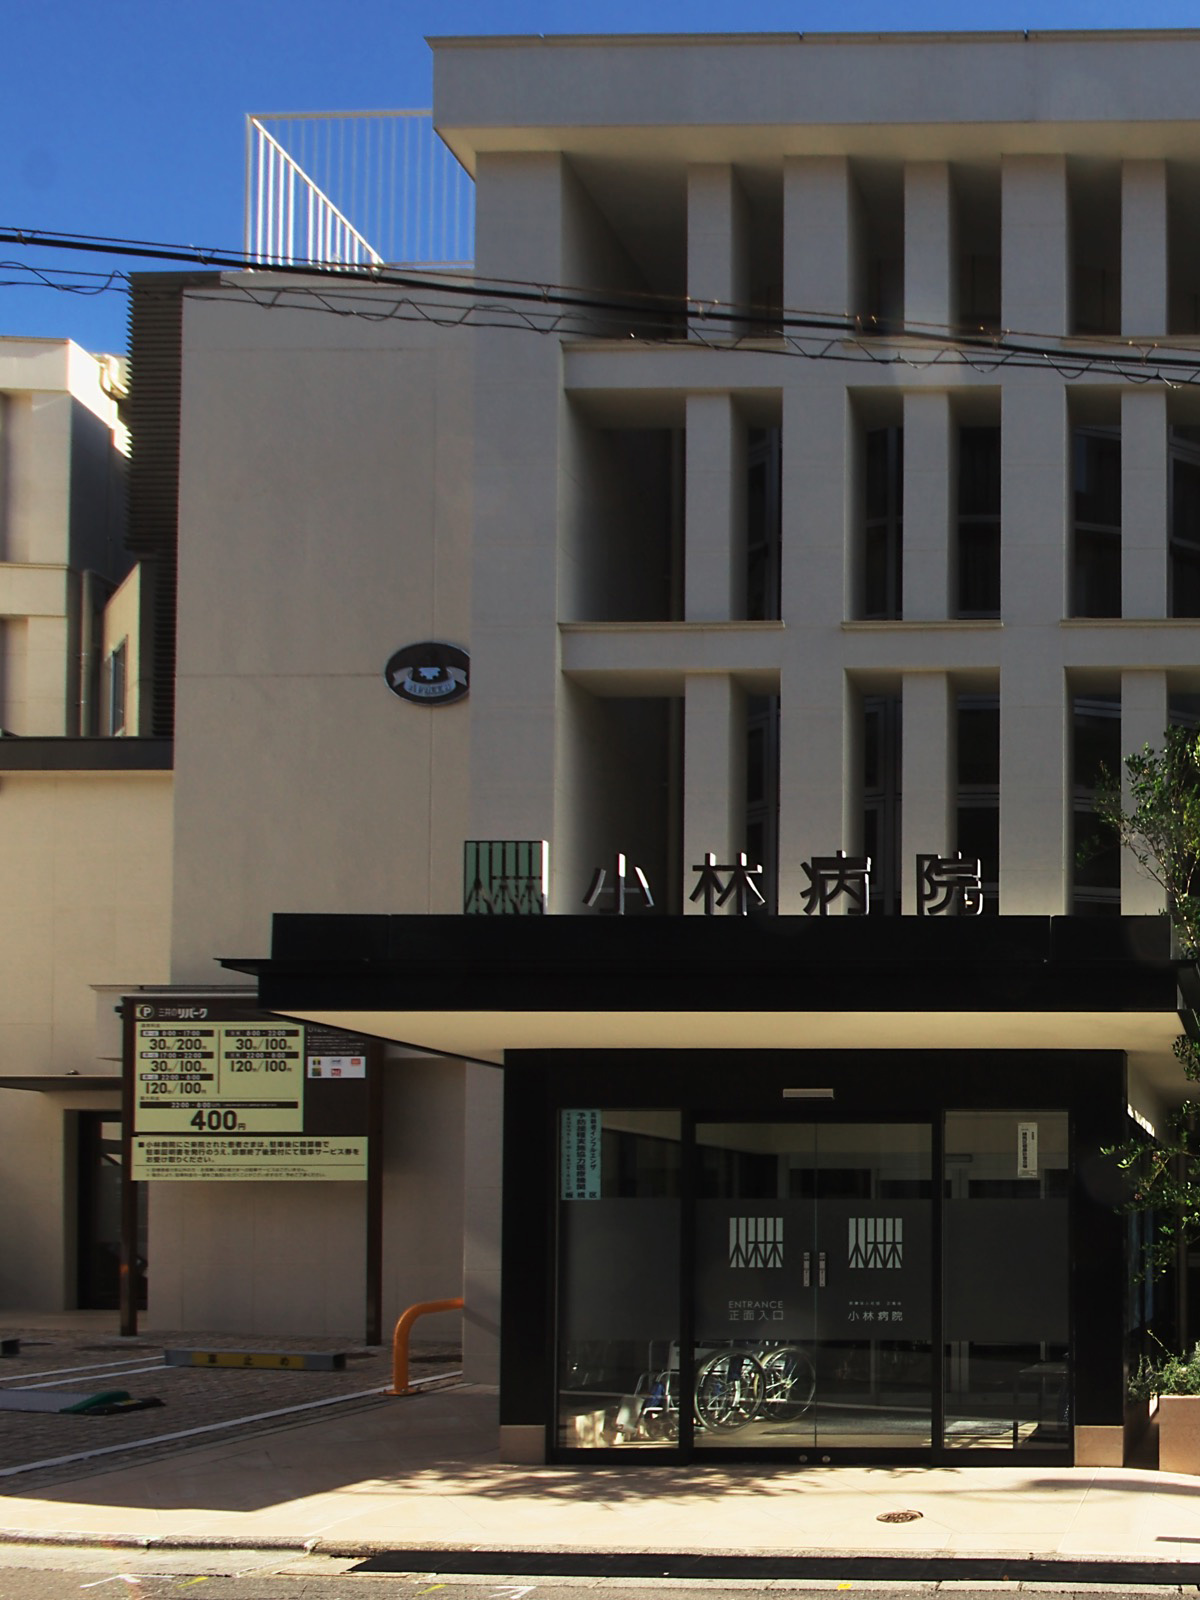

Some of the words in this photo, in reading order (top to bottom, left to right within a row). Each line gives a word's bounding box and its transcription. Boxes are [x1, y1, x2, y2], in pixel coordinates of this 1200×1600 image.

[583, 850, 983, 916] 小林病院
[728, 1300, 784, 1309] ENTRANCE
[728, 1310, 785, 1321] 正面入口
[847, 1311, 903, 1322] 小林病院
